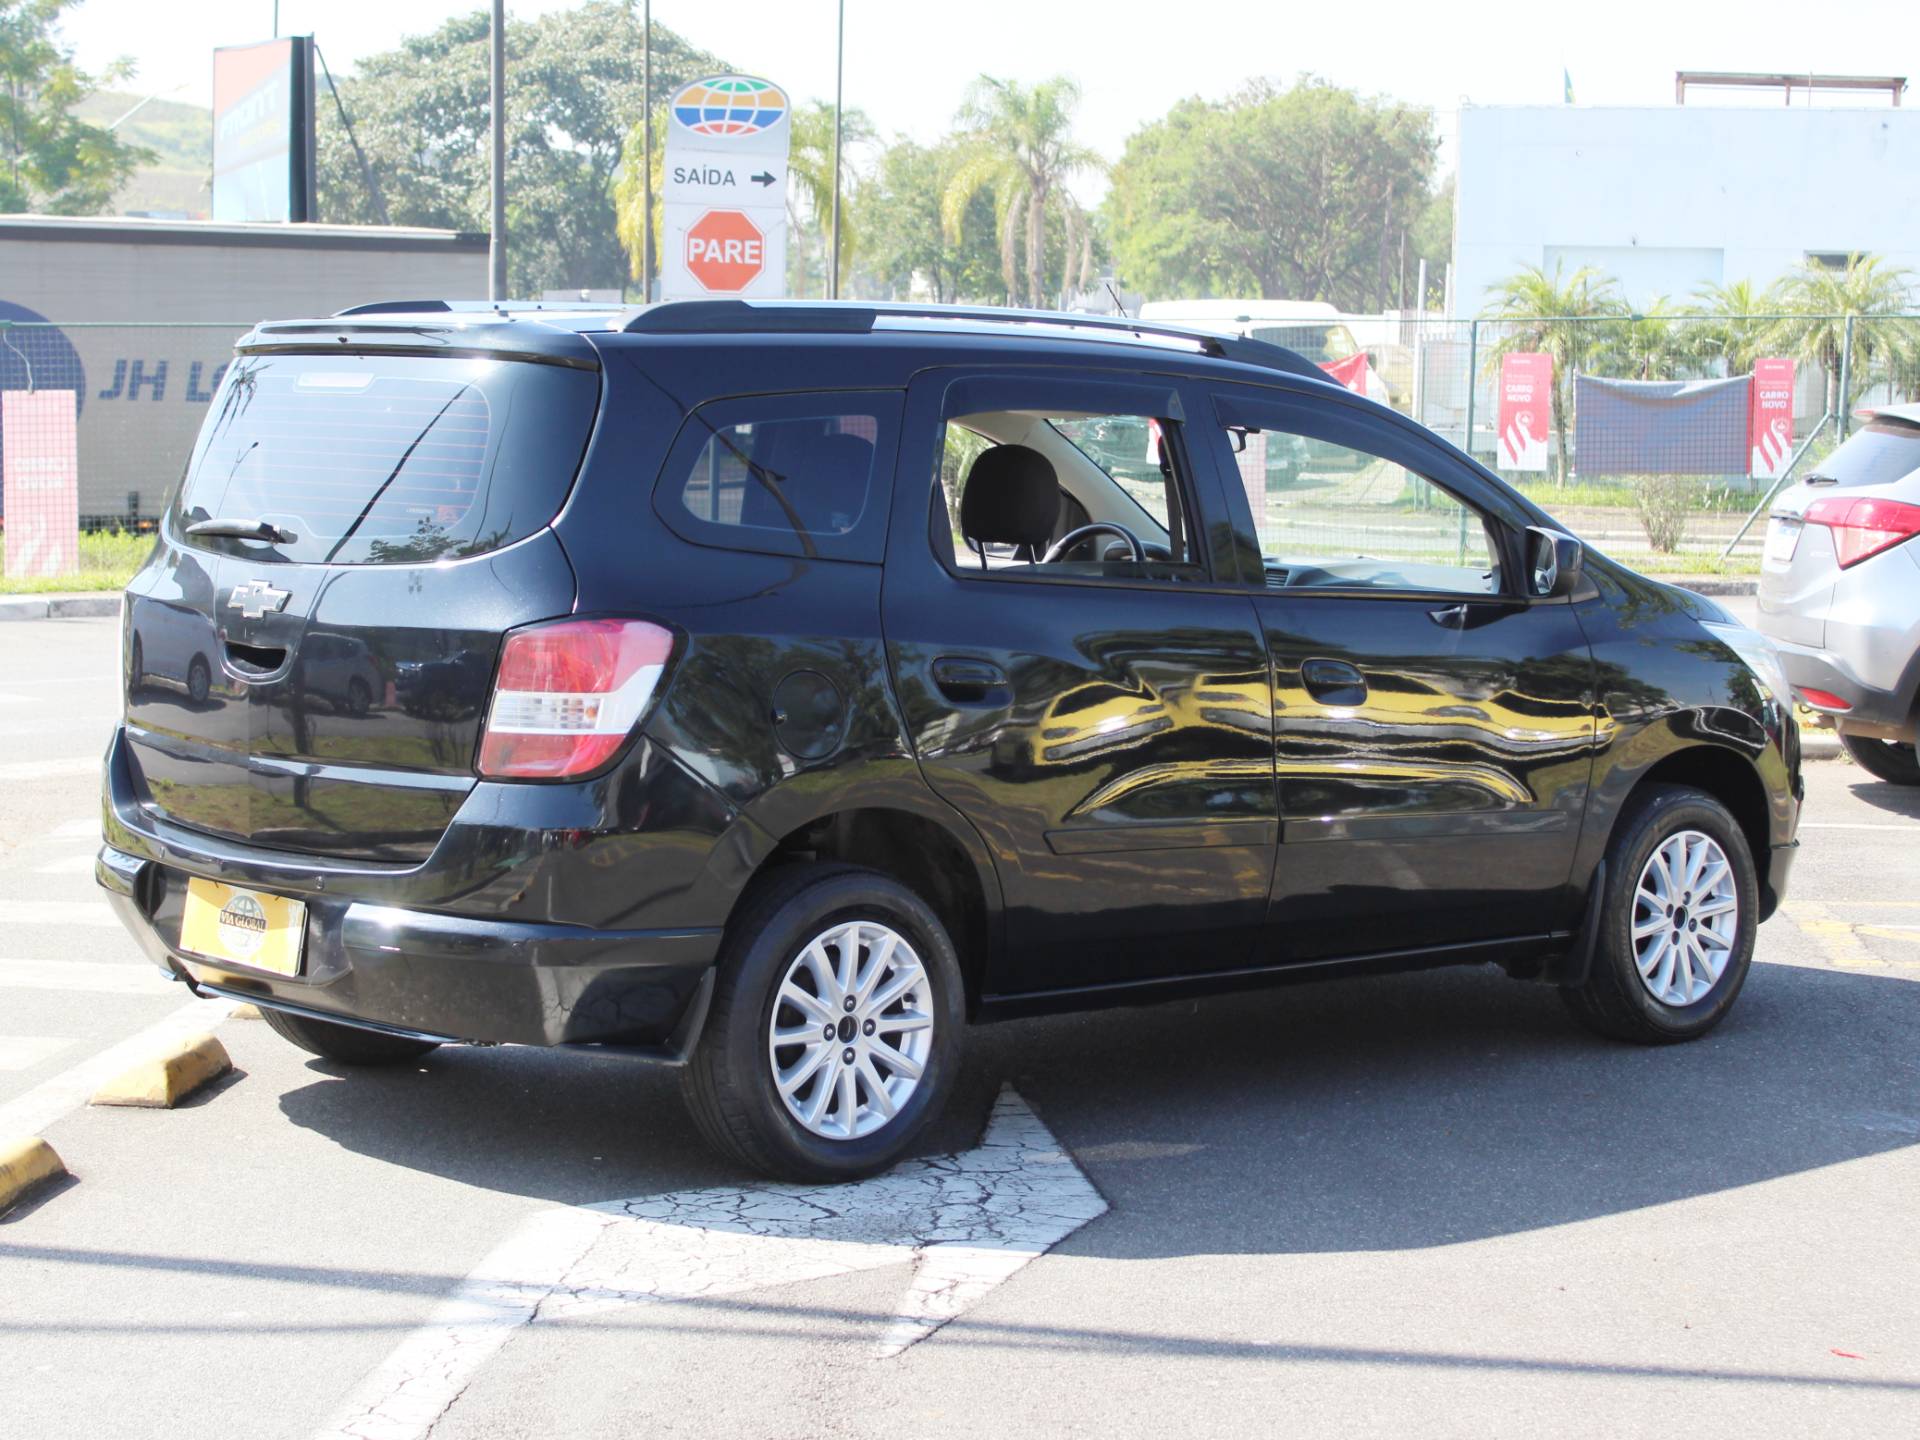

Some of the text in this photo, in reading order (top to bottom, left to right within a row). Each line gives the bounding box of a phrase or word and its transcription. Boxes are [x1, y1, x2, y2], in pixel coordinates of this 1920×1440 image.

[674, 164, 736, 186] SAÍDA
[689, 238, 761, 265] PARE
[98, 360, 169, 401] JH
[1505, 384, 1534, 393] CARRO
[1759, 391, 1789, 399] CARRO
[1761, 400, 1787, 408] NOVO
[221, 911, 265, 931] VIA GLOBAL
